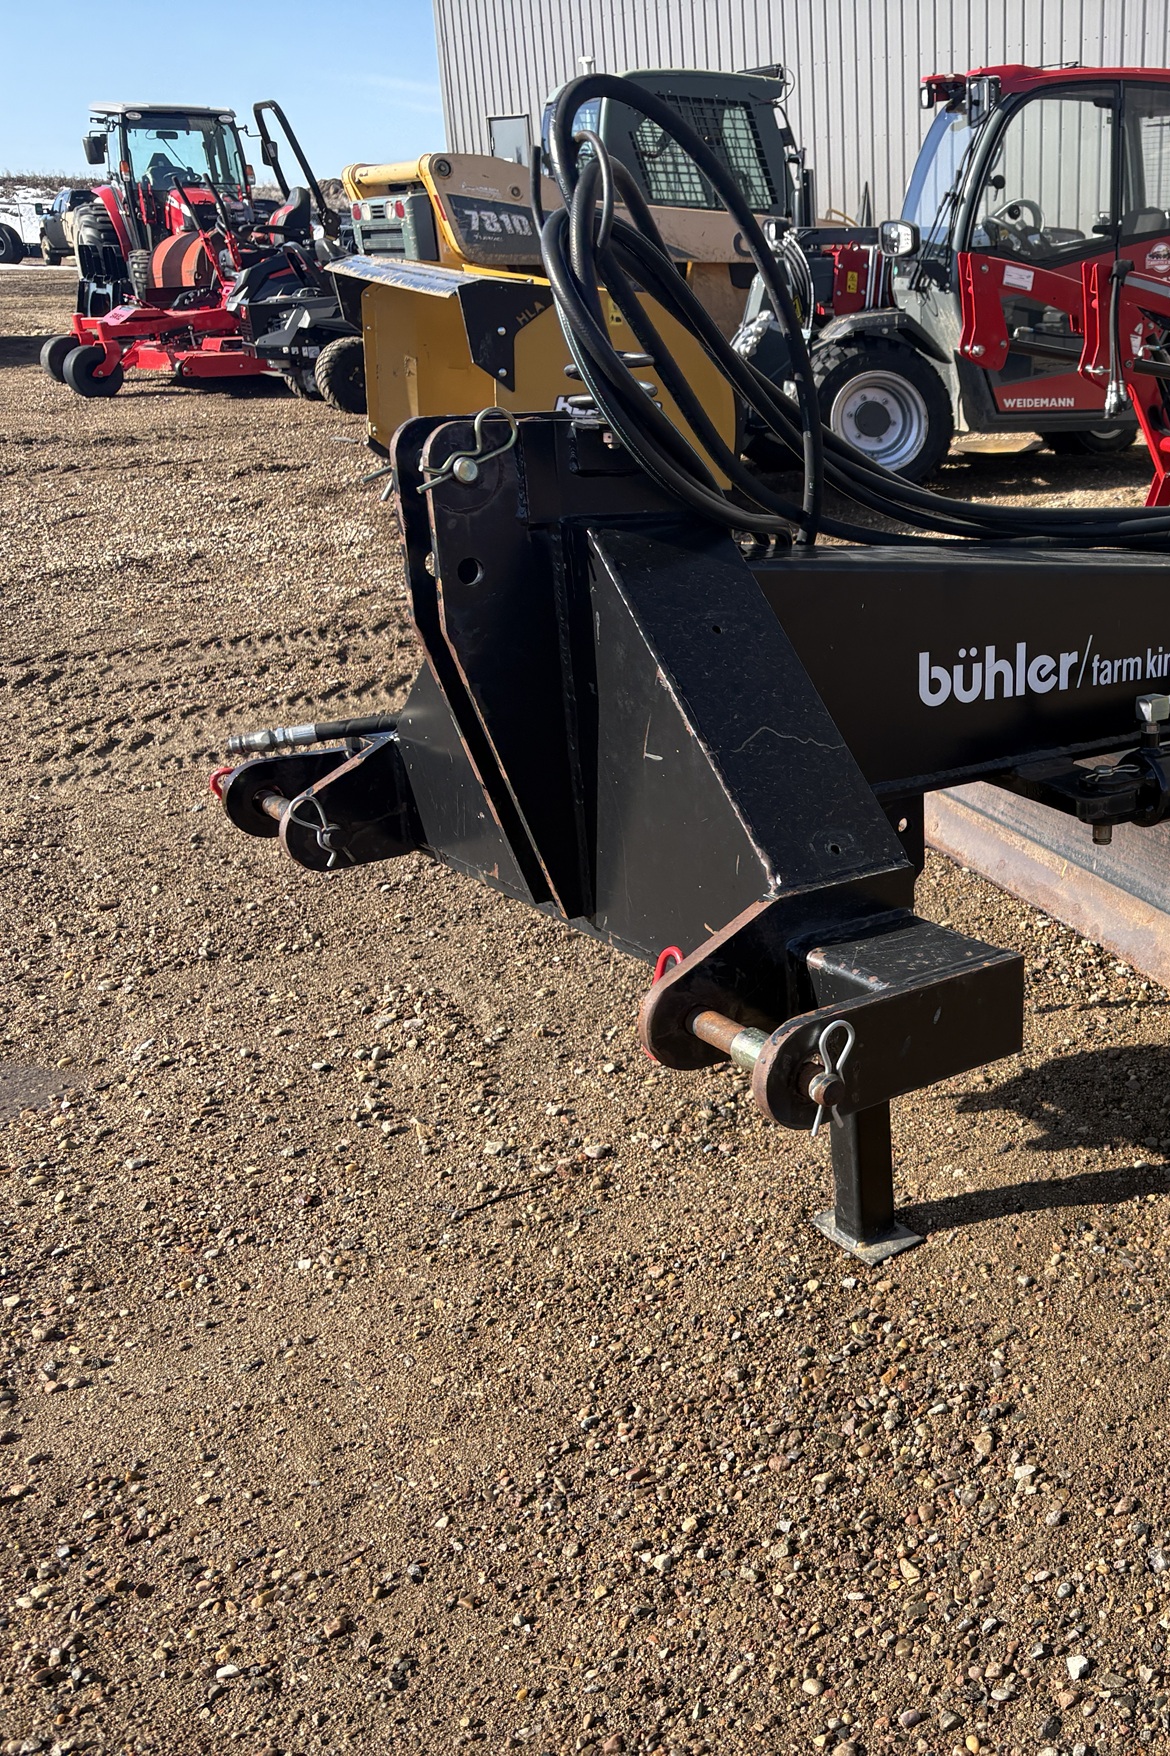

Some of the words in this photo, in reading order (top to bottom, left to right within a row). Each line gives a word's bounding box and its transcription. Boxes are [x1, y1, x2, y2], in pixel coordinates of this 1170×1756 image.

[463, 209, 533, 237] 7810
[515, 301, 546, 326] HLA
[1003, 397, 1075, 408] WEIDEMANN
[1092, 653, 1142, 687] farm
